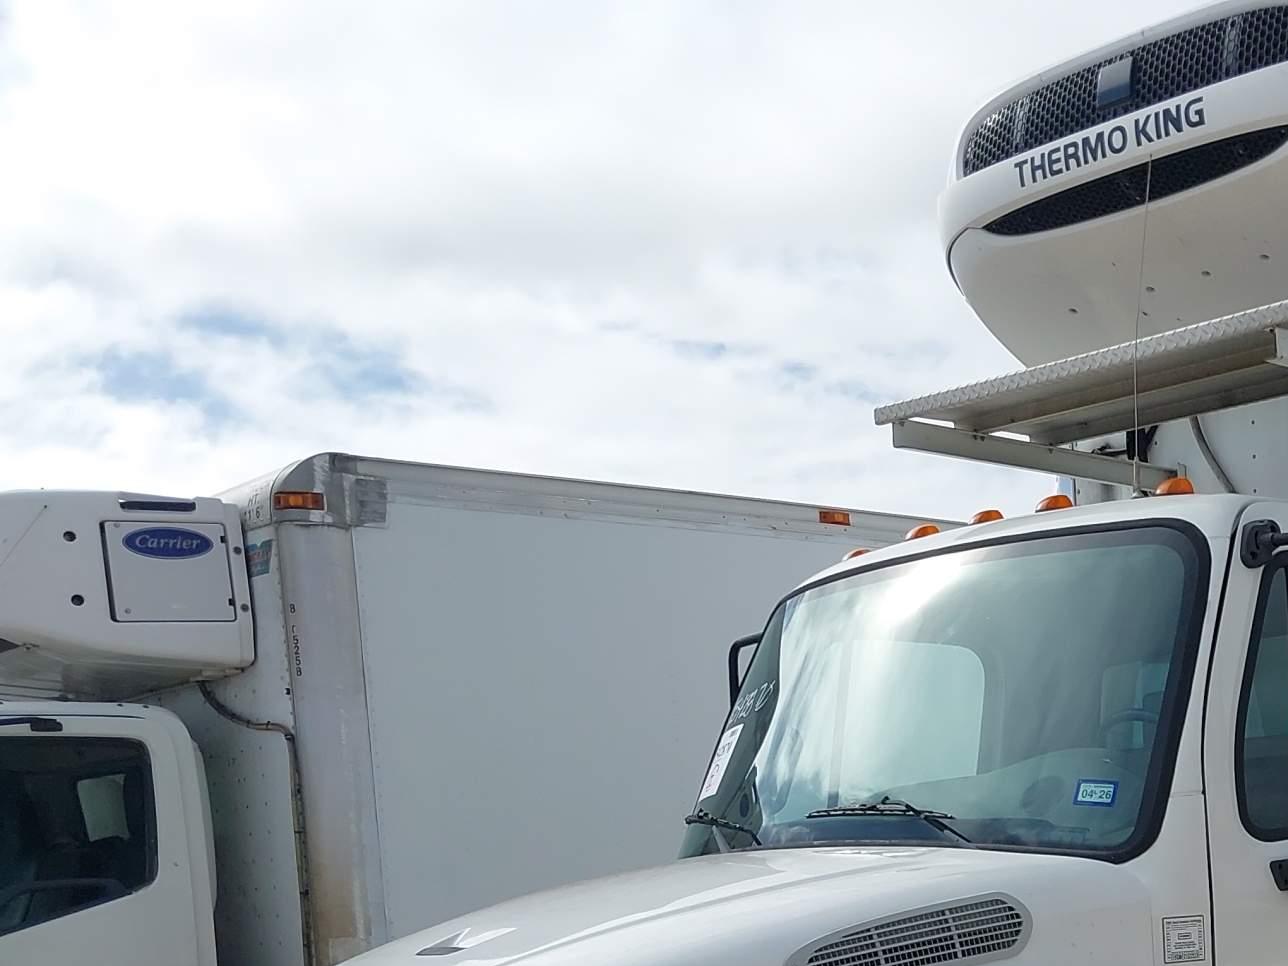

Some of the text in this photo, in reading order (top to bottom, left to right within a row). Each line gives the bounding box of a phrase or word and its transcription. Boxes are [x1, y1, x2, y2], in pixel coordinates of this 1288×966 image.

[1014, 96, 1206, 187] THERMO KING
[136, 534, 201, 550] Carrier
[1081, 789, 1111, 800] 04 26
